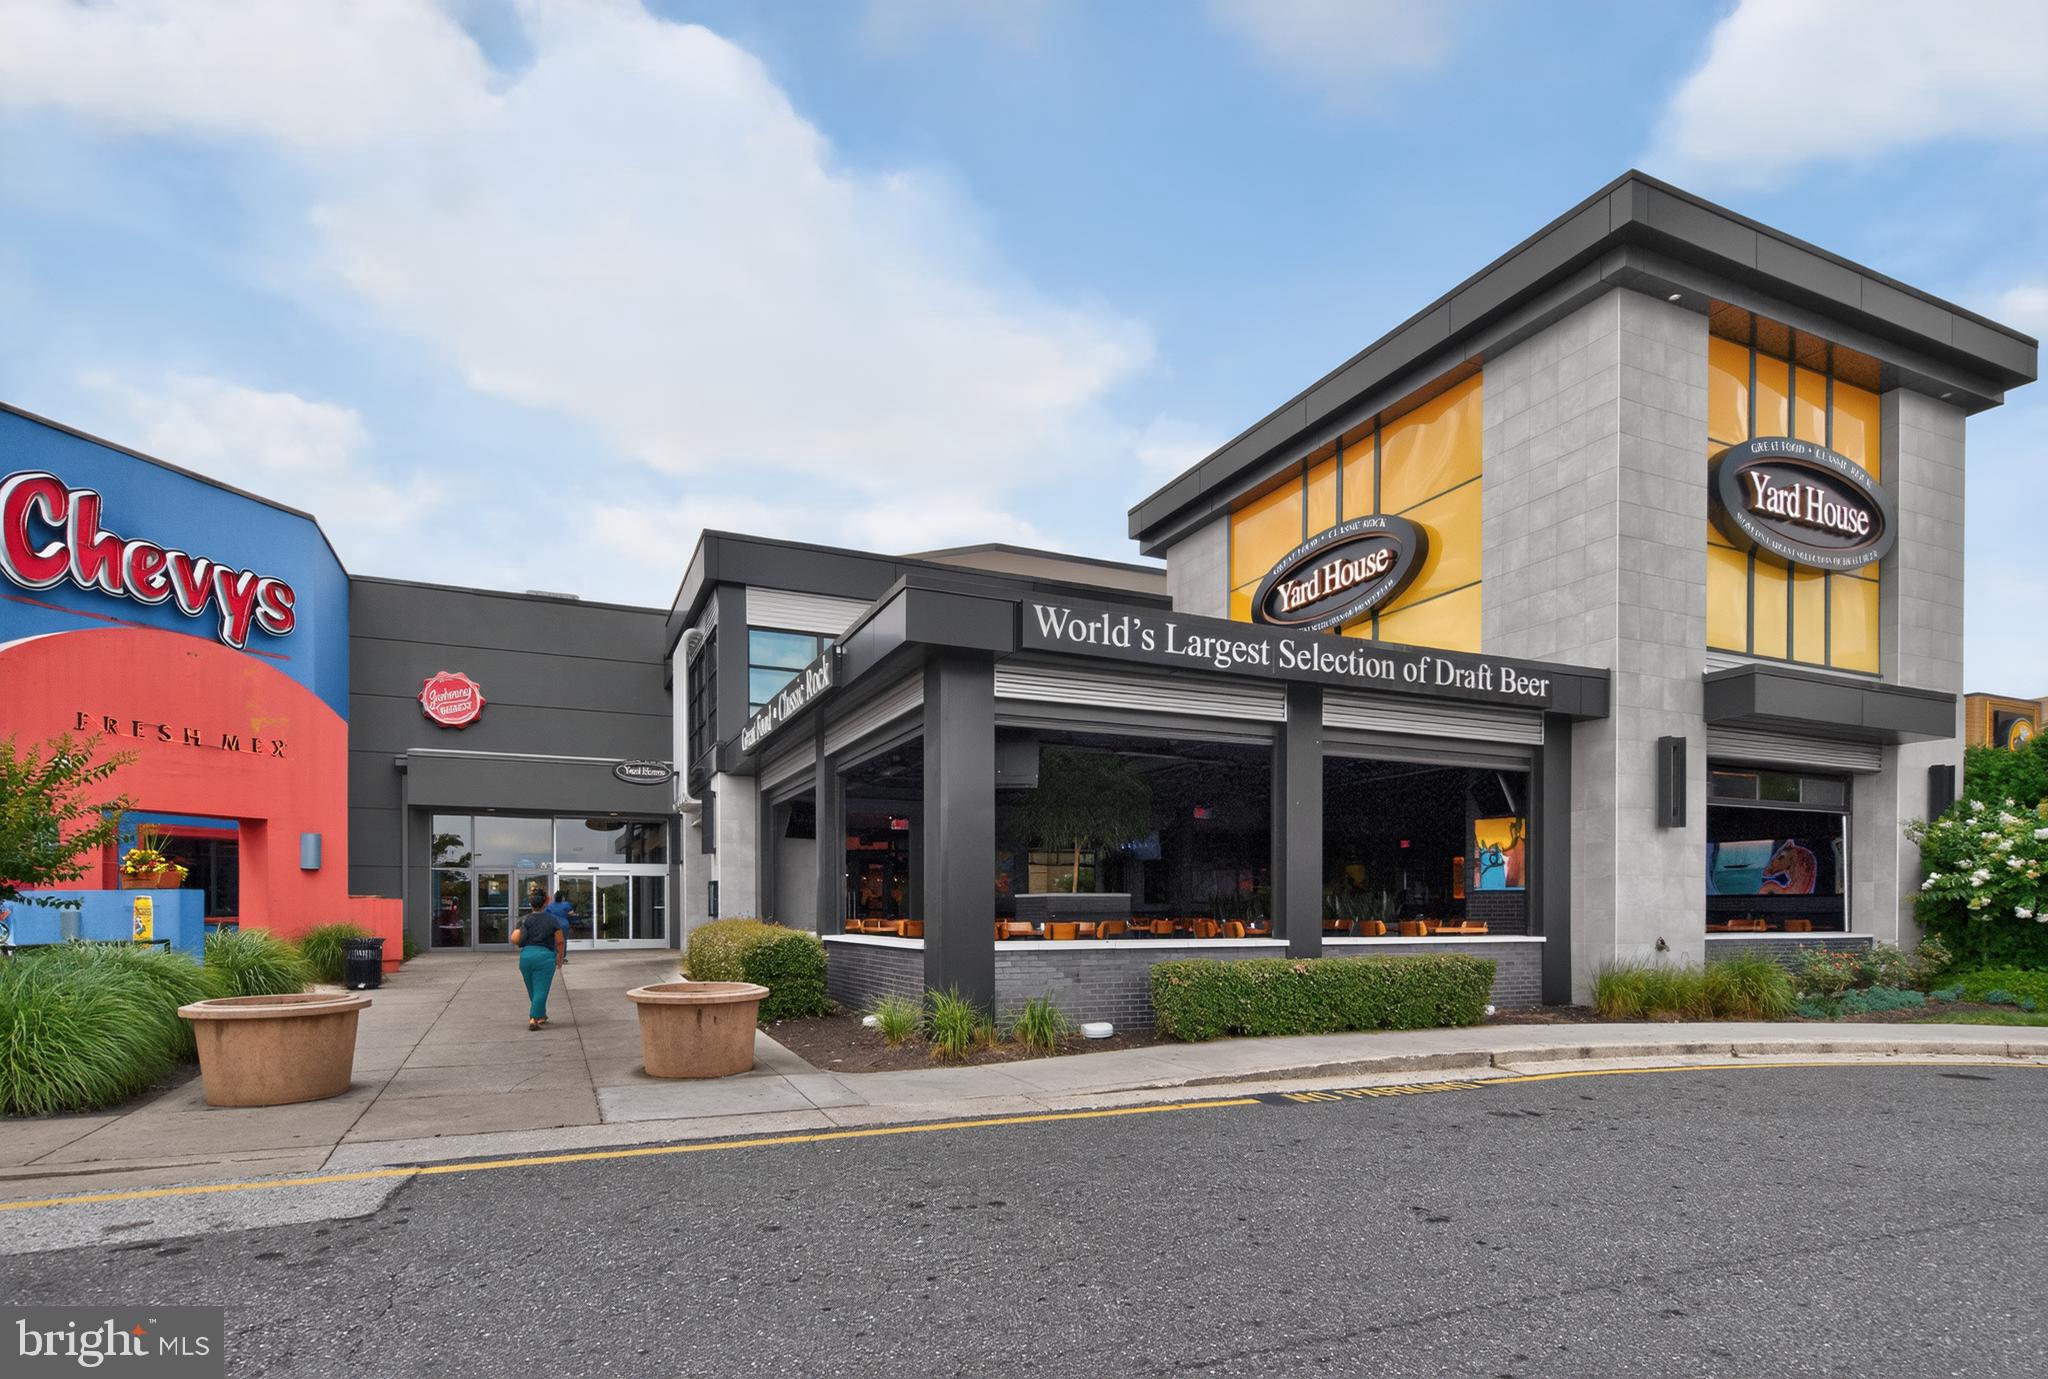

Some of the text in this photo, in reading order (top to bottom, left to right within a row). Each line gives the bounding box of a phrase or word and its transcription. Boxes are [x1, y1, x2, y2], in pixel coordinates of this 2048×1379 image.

[1750, 471, 1870, 536] Yard House
[0, 471, 297, 650] Chevys
[1277, 569, 1320, 613] Yard
[1322, 548, 1390, 593] House
[806, 654, 830, 701] Rock
[1032, 604, 1550, 697] World's Largest Selection of Draft Beer
[73, 711, 288, 758] FRESH MEX
